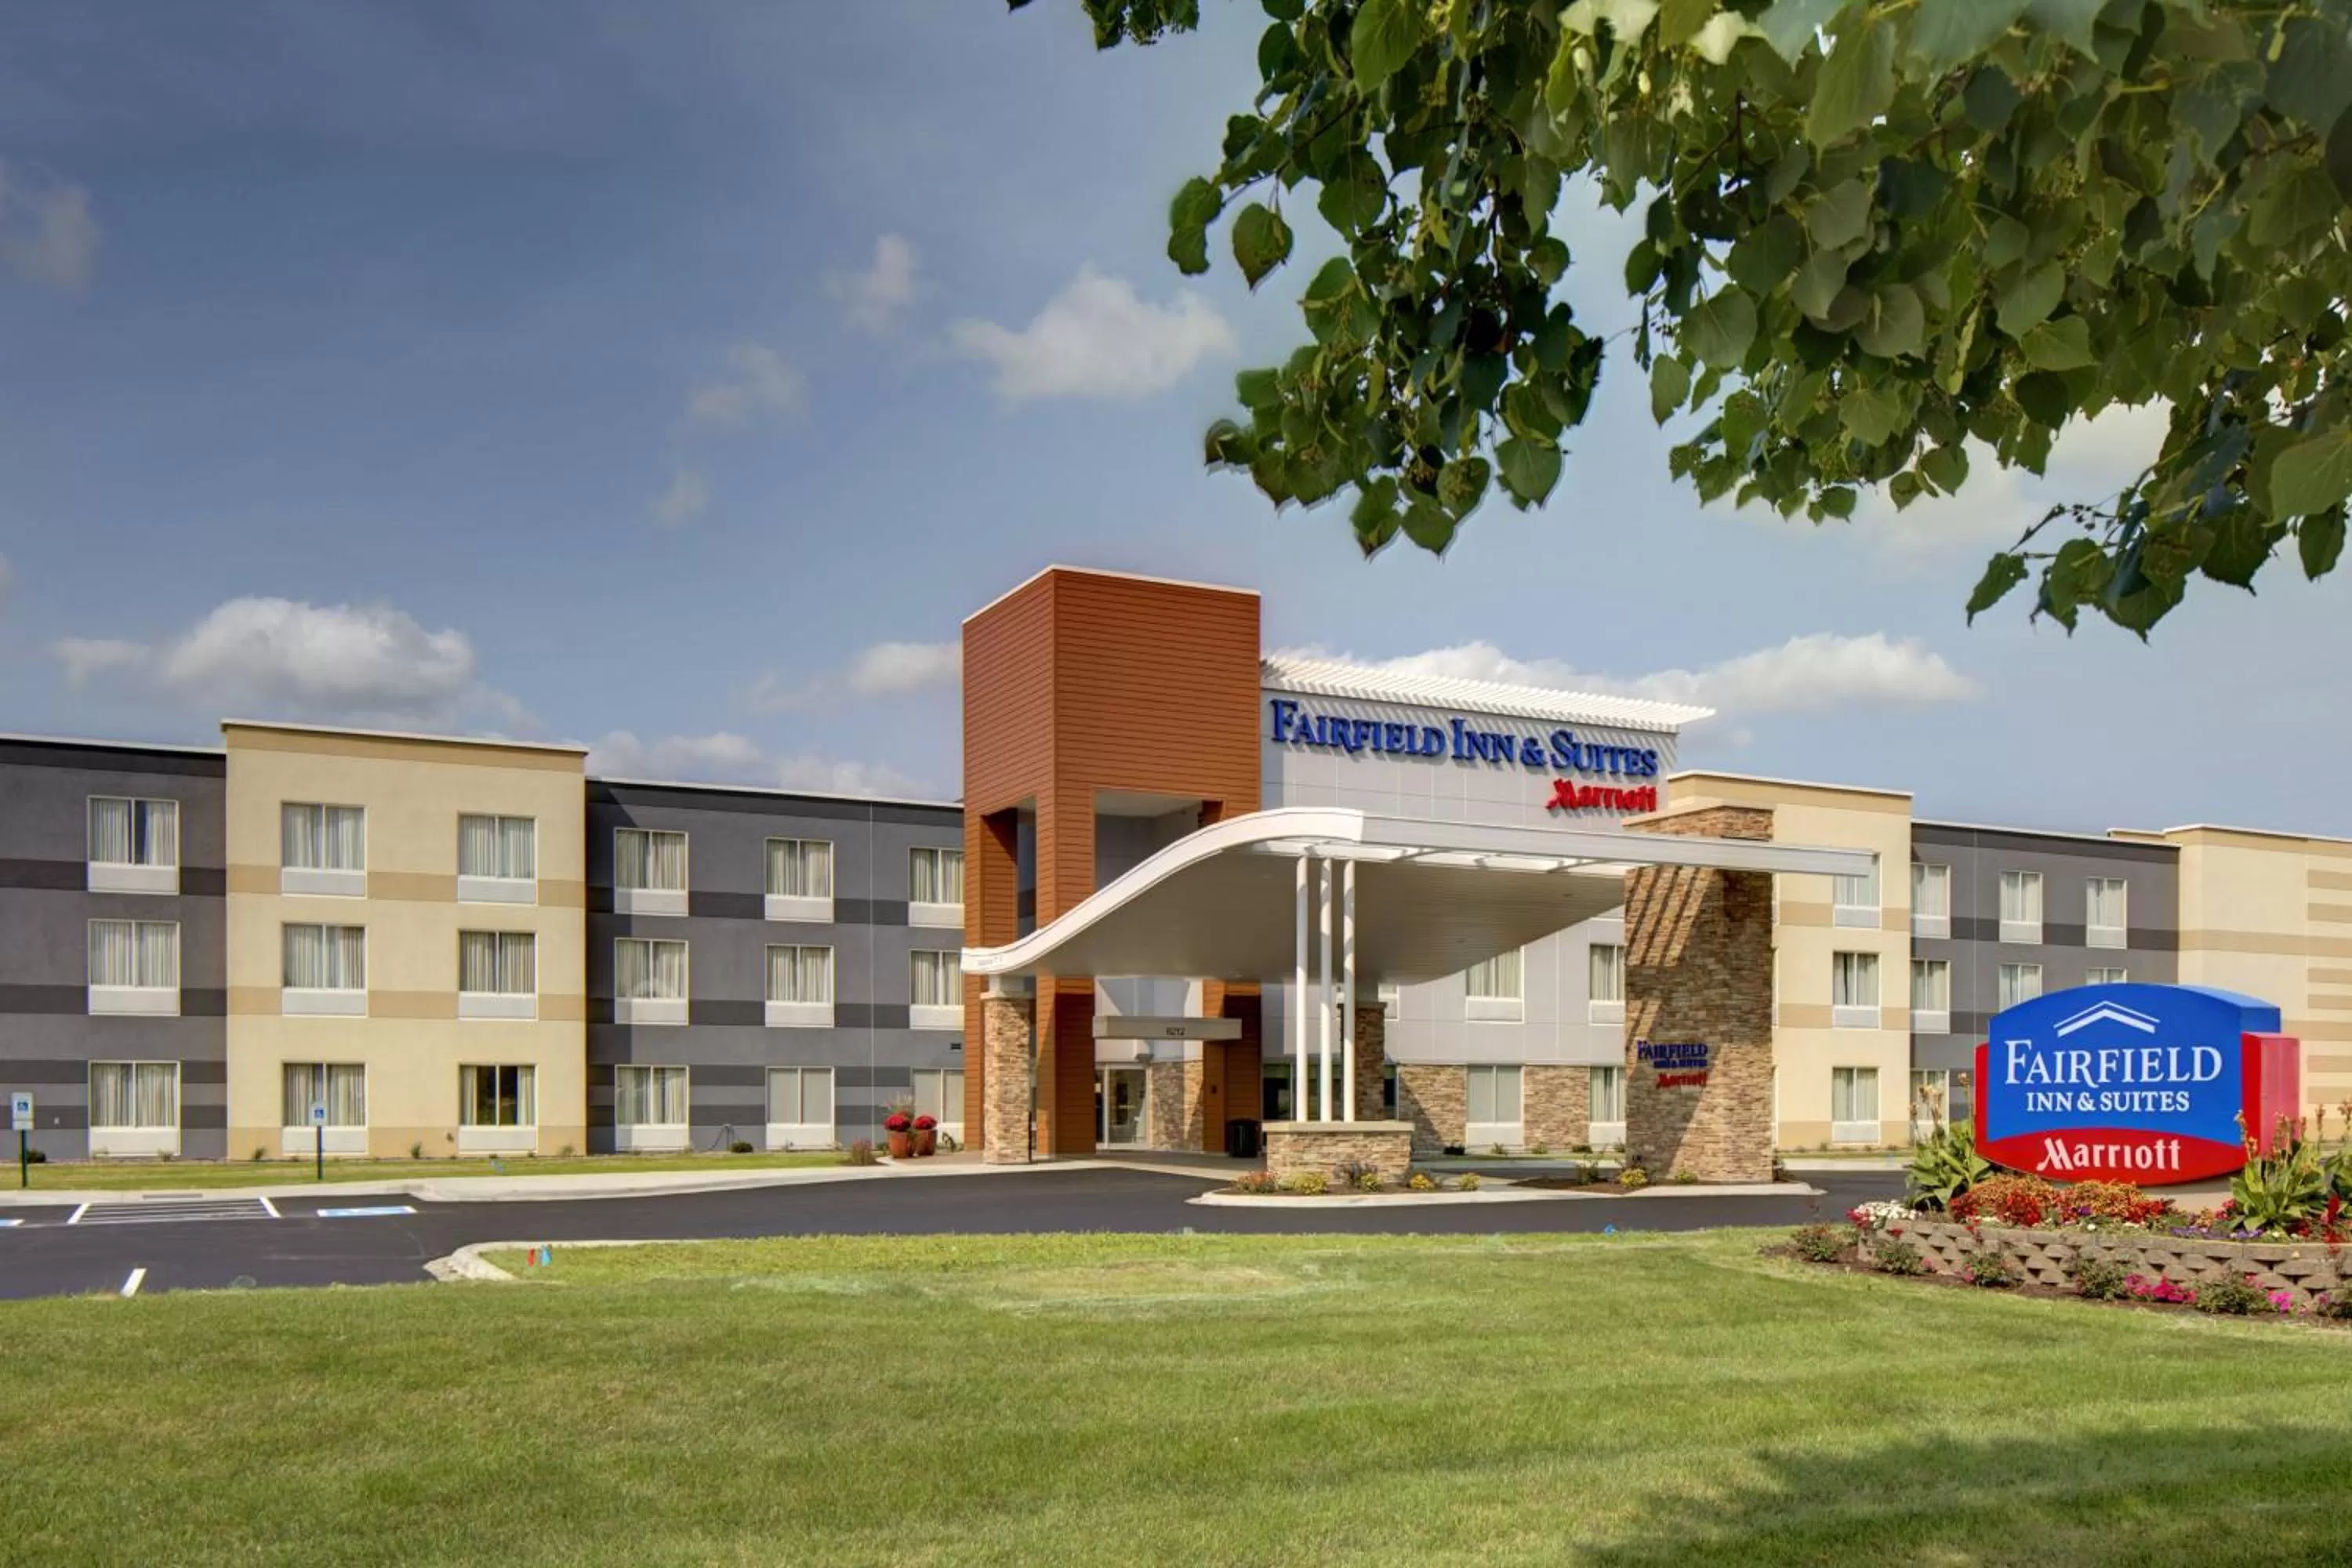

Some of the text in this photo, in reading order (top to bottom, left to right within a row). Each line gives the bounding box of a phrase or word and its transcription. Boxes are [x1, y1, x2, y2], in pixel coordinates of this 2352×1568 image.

[1270, 699, 1658, 776] FAIRFIELD INN & SUITES
[1546, 779, 1657, 812] Marriott
[2004, 1040, 2223, 1088] FAIRFIELD
[2027, 1092, 2190, 1112] INN & SUITES
[2036, 1138, 2181, 1171] Marriott
